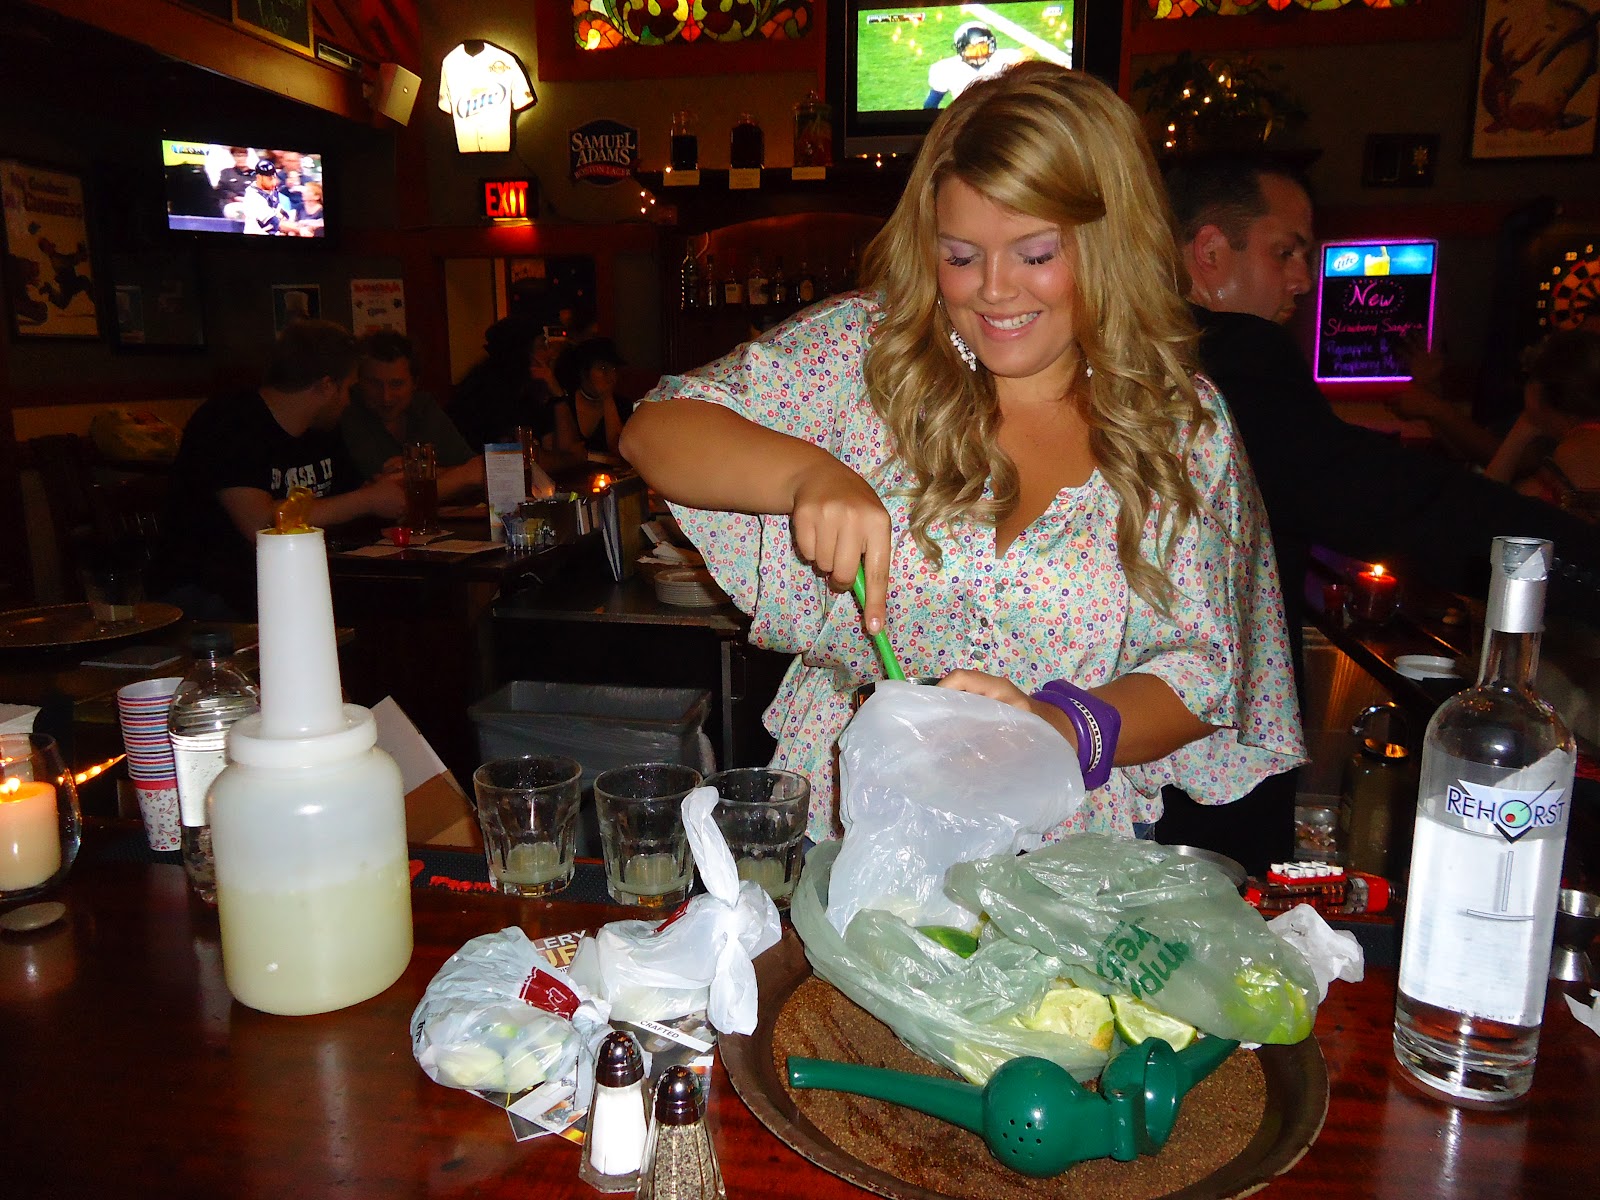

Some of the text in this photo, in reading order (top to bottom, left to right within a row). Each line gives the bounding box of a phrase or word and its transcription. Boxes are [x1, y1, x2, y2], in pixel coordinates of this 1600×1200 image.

[571, 131, 636, 152] SAMUEL
[575, 148, 631, 168] ADAMS
[485, 181, 529, 217] EXIT
[1335, 256, 1357, 270] Lite
[1348, 282, 1394, 307] New
[1323, 317, 1424, 337] Strawberry Sangria
[1446, 787, 1565, 829] REHORST
[639, 1020, 681, 1040] CRAFTED
